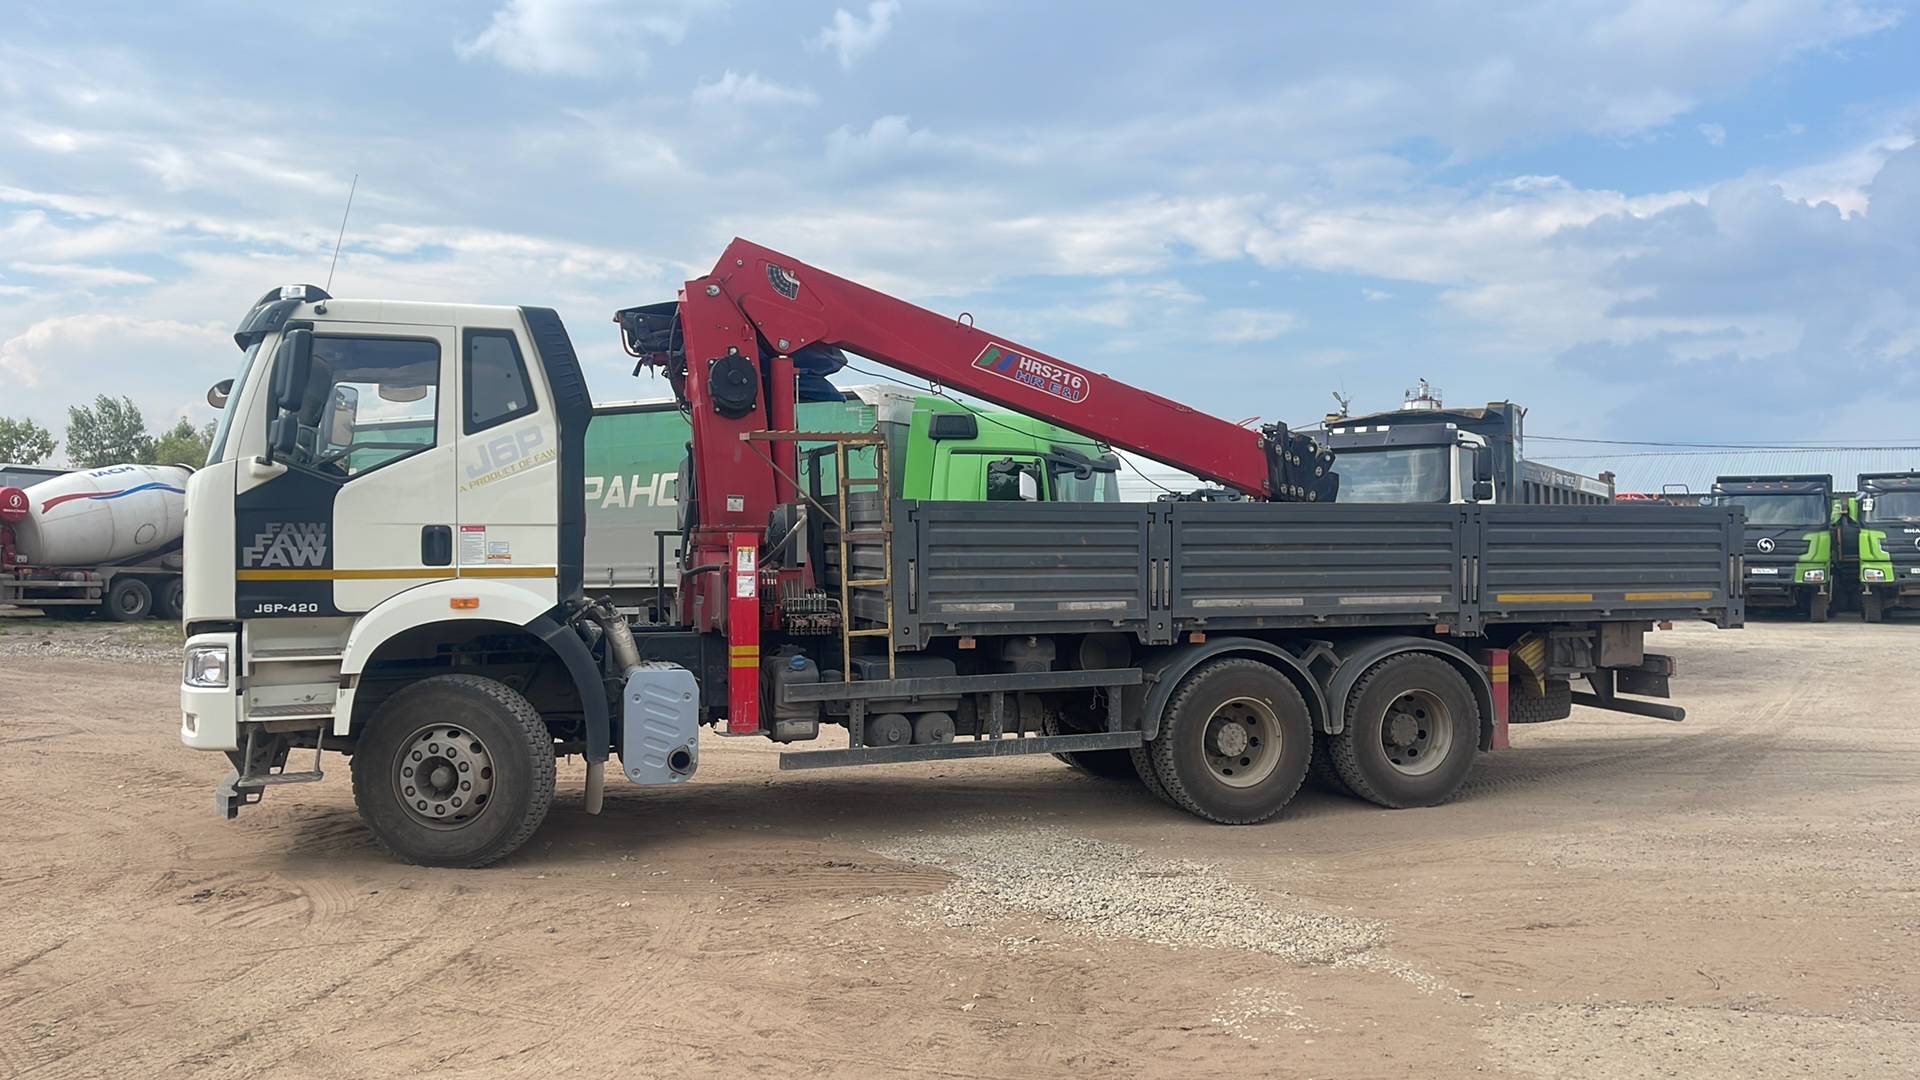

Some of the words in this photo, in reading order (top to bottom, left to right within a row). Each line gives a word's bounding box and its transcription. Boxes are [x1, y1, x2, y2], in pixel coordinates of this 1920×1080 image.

[1015, 369, 1045, 389] HR
[1019, 357, 1082, 389] HRS216
[465, 425, 544, 479] J6P
[468, 463, 518, 489] PRODUCT
[518, 458, 530, 469] OF
[533, 447, 557, 462] FAW
[265, 522, 327, 535] FAW
[255, 533, 327, 549] FAW
[243, 546, 327, 568] FAW
[254, 602, 319, 614] J6P-420
